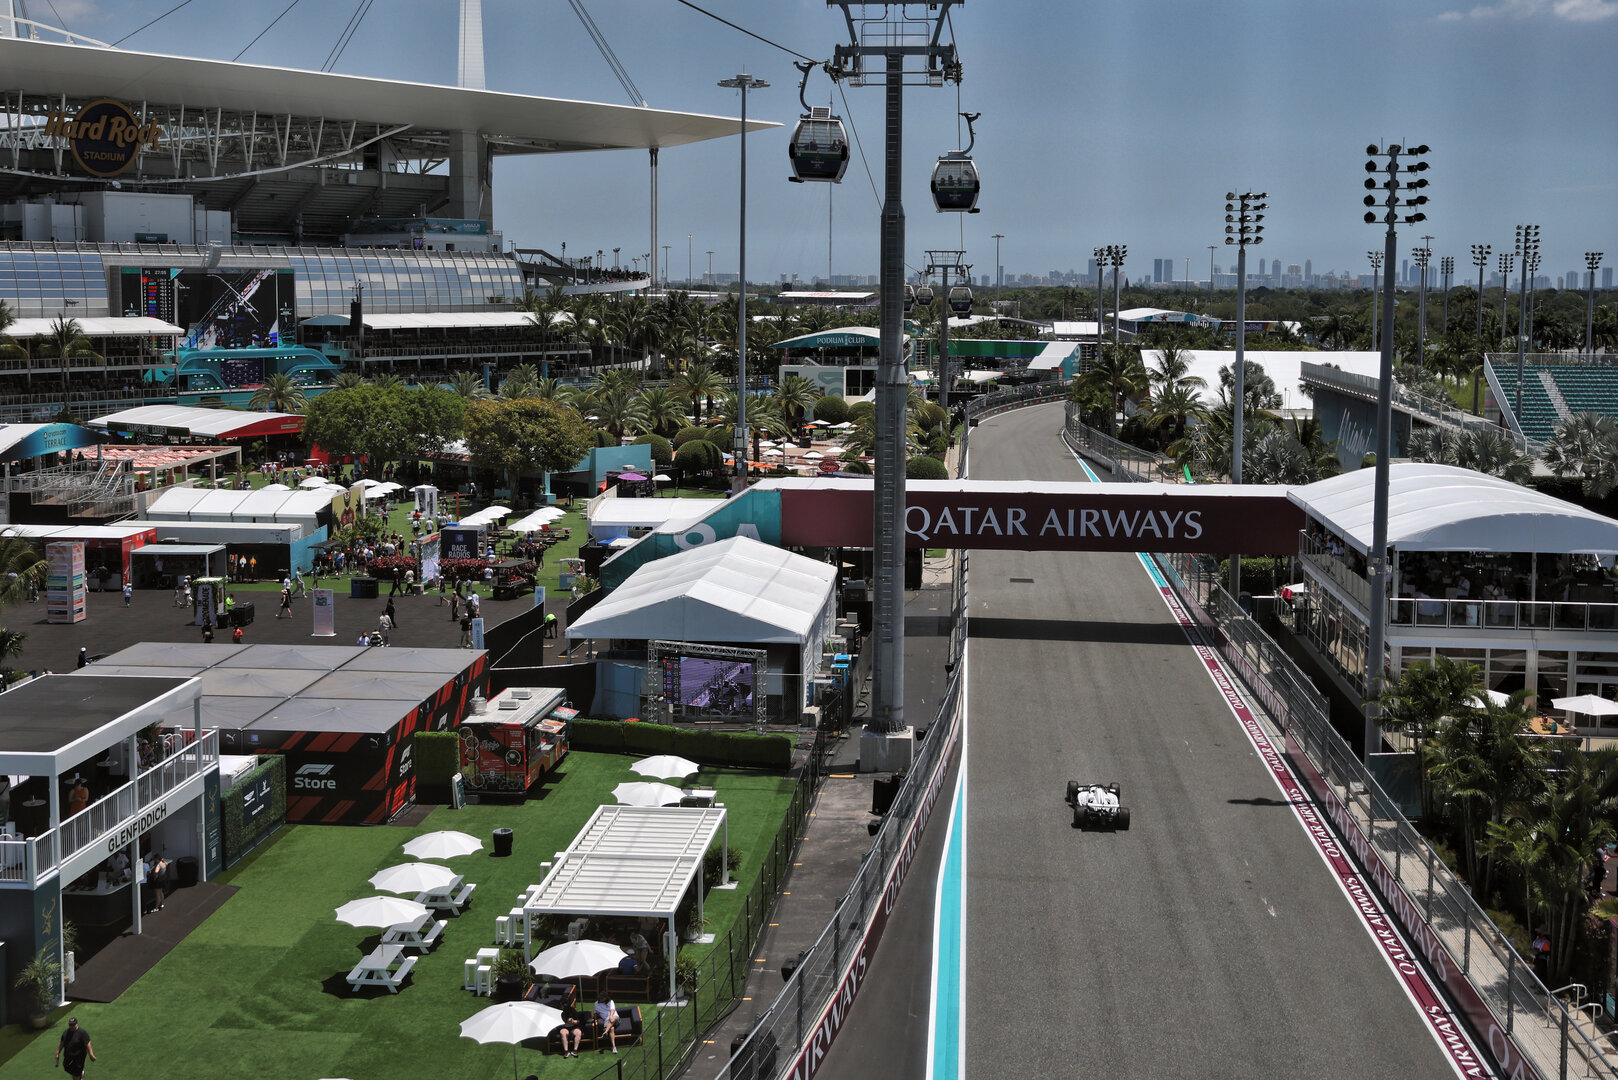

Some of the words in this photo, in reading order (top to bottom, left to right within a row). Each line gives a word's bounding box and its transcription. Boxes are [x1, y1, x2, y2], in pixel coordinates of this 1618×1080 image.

[45, 111, 108, 141] Hard
[108, 116, 163, 149] Rock
[83, 151, 126, 162] STADIUM
[848, 336, 866, 344] CLUB
[44, 437, 67, 449] TERRACE
[905, 506, 1029, 541] QATAR
[1039, 509, 1203, 540] AIRWAYS
[448, 551, 471, 559] RADIOS
[451, 544, 468, 552] RACE
[1253, 676, 1289, 728] AIRWAY
[1261, 747, 1285, 772] QATAR
[294, 777, 336, 789] Store
[1287, 787, 1317, 824] AIRWAYS
[108, 802, 167, 852] GLENFIDDICH
[1310, 825, 1340, 858] QATAR
[885, 828, 917, 915] QATAR
[1325, 790, 1369, 872] QATAR
[1372, 859, 1448, 982] AIRWAYS
[1343, 876, 1386, 927] AIRWAYS
[1376, 929, 1417, 976] QATAR
[1425, 1004, 1488, 1080] AIRWAYS
[1488, 1023, 1537, 1080] QA
